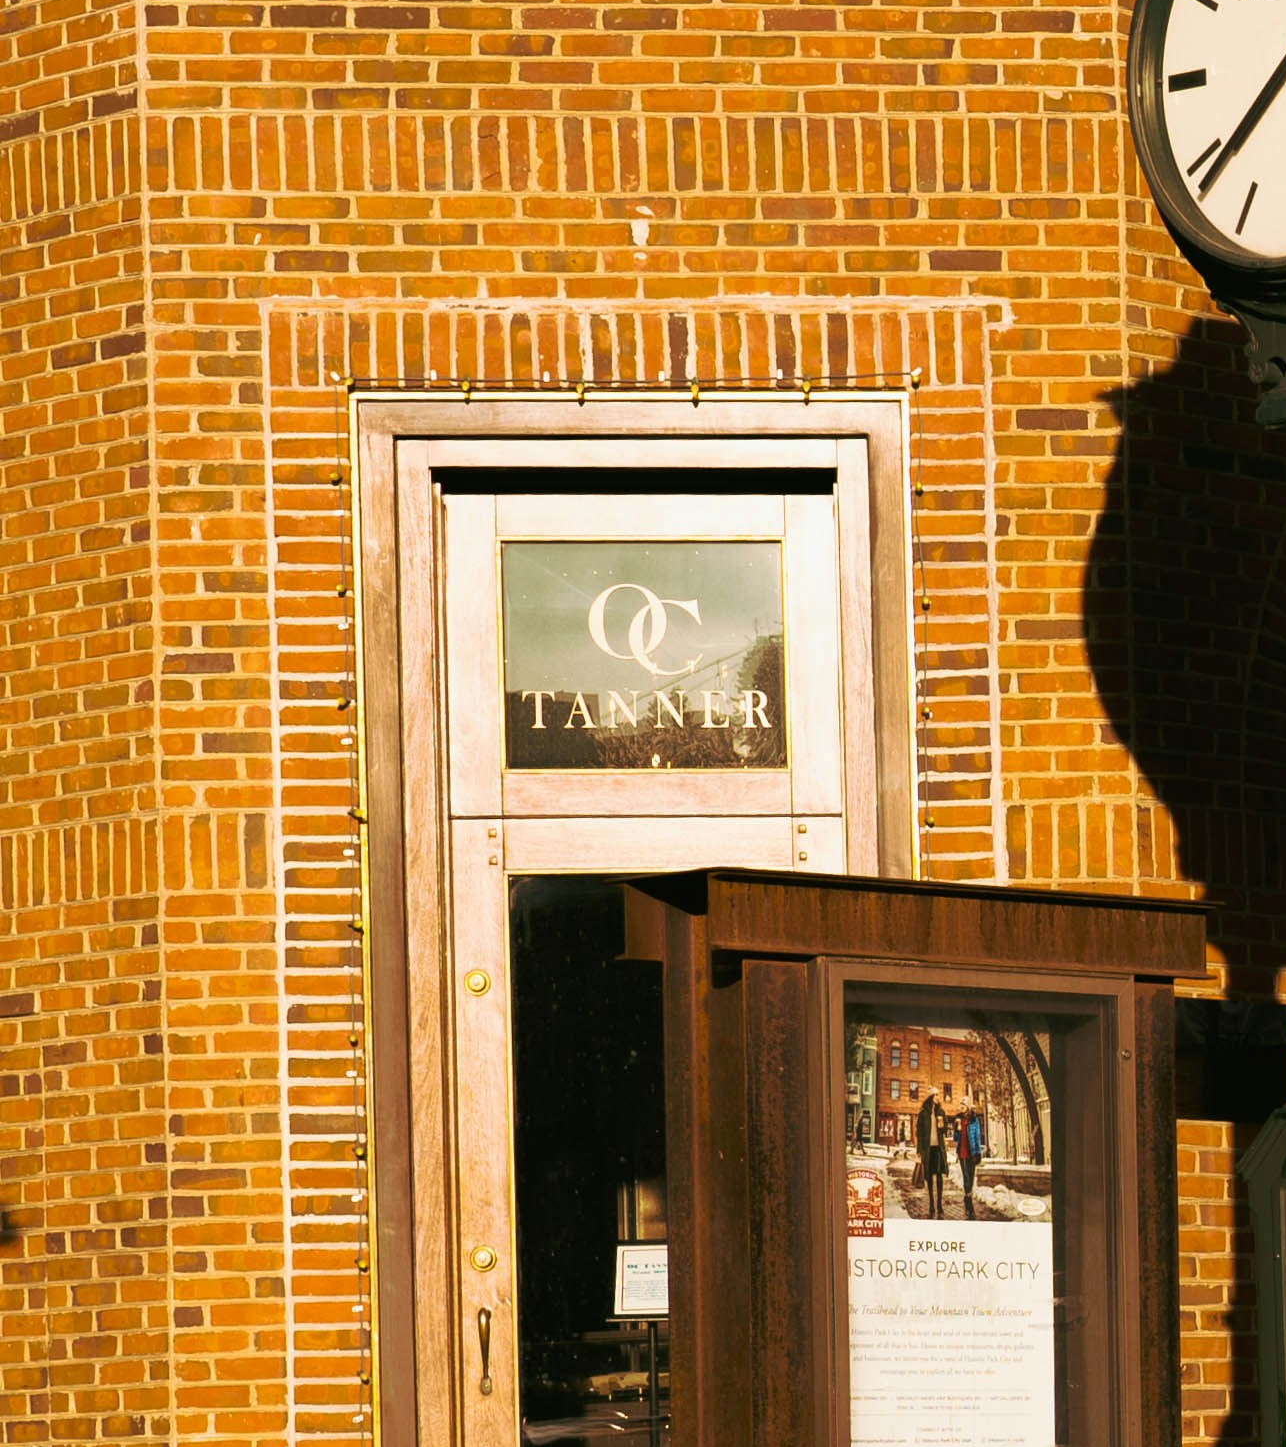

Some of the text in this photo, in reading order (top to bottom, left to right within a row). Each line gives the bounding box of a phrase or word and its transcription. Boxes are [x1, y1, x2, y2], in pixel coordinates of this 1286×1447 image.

[521, 690, 773, 730] TANNER
[847, 1219, 883, 1228] ARK CITY
[909, 1240, 966, 1252] EXPLORE
[848, 1258, 1040, 1280] ISTORIC PARK CITY
[930, 1306, 969, 1317] Mountain
